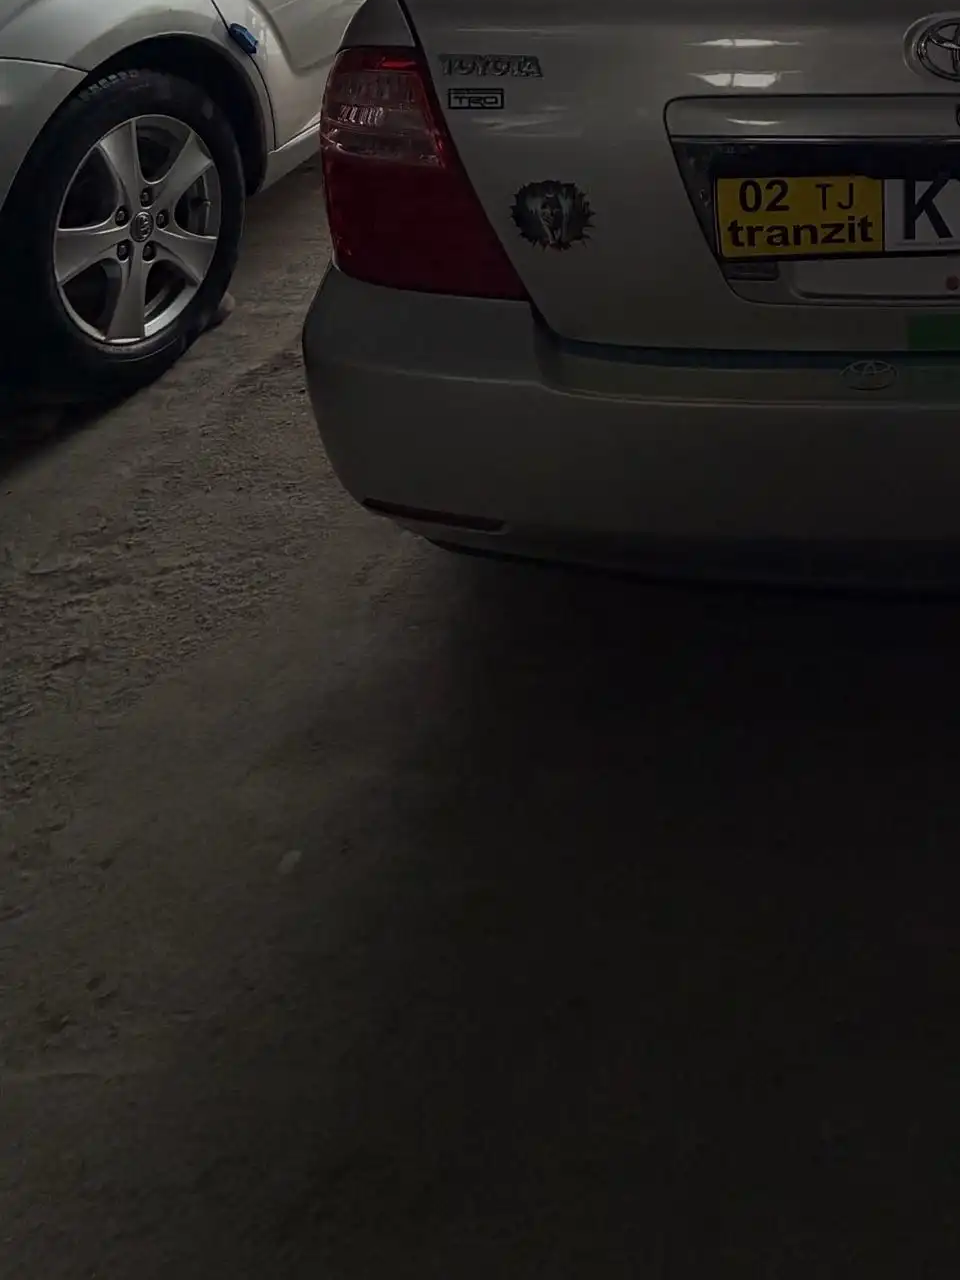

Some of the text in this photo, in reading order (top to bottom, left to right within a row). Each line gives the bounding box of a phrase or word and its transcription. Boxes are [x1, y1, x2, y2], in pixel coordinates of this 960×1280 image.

[438, 53, 545, 78] TOYOTA
[738, 179, 855, 214] 02 TJ
[727, 214, 874, 248] tranzit
